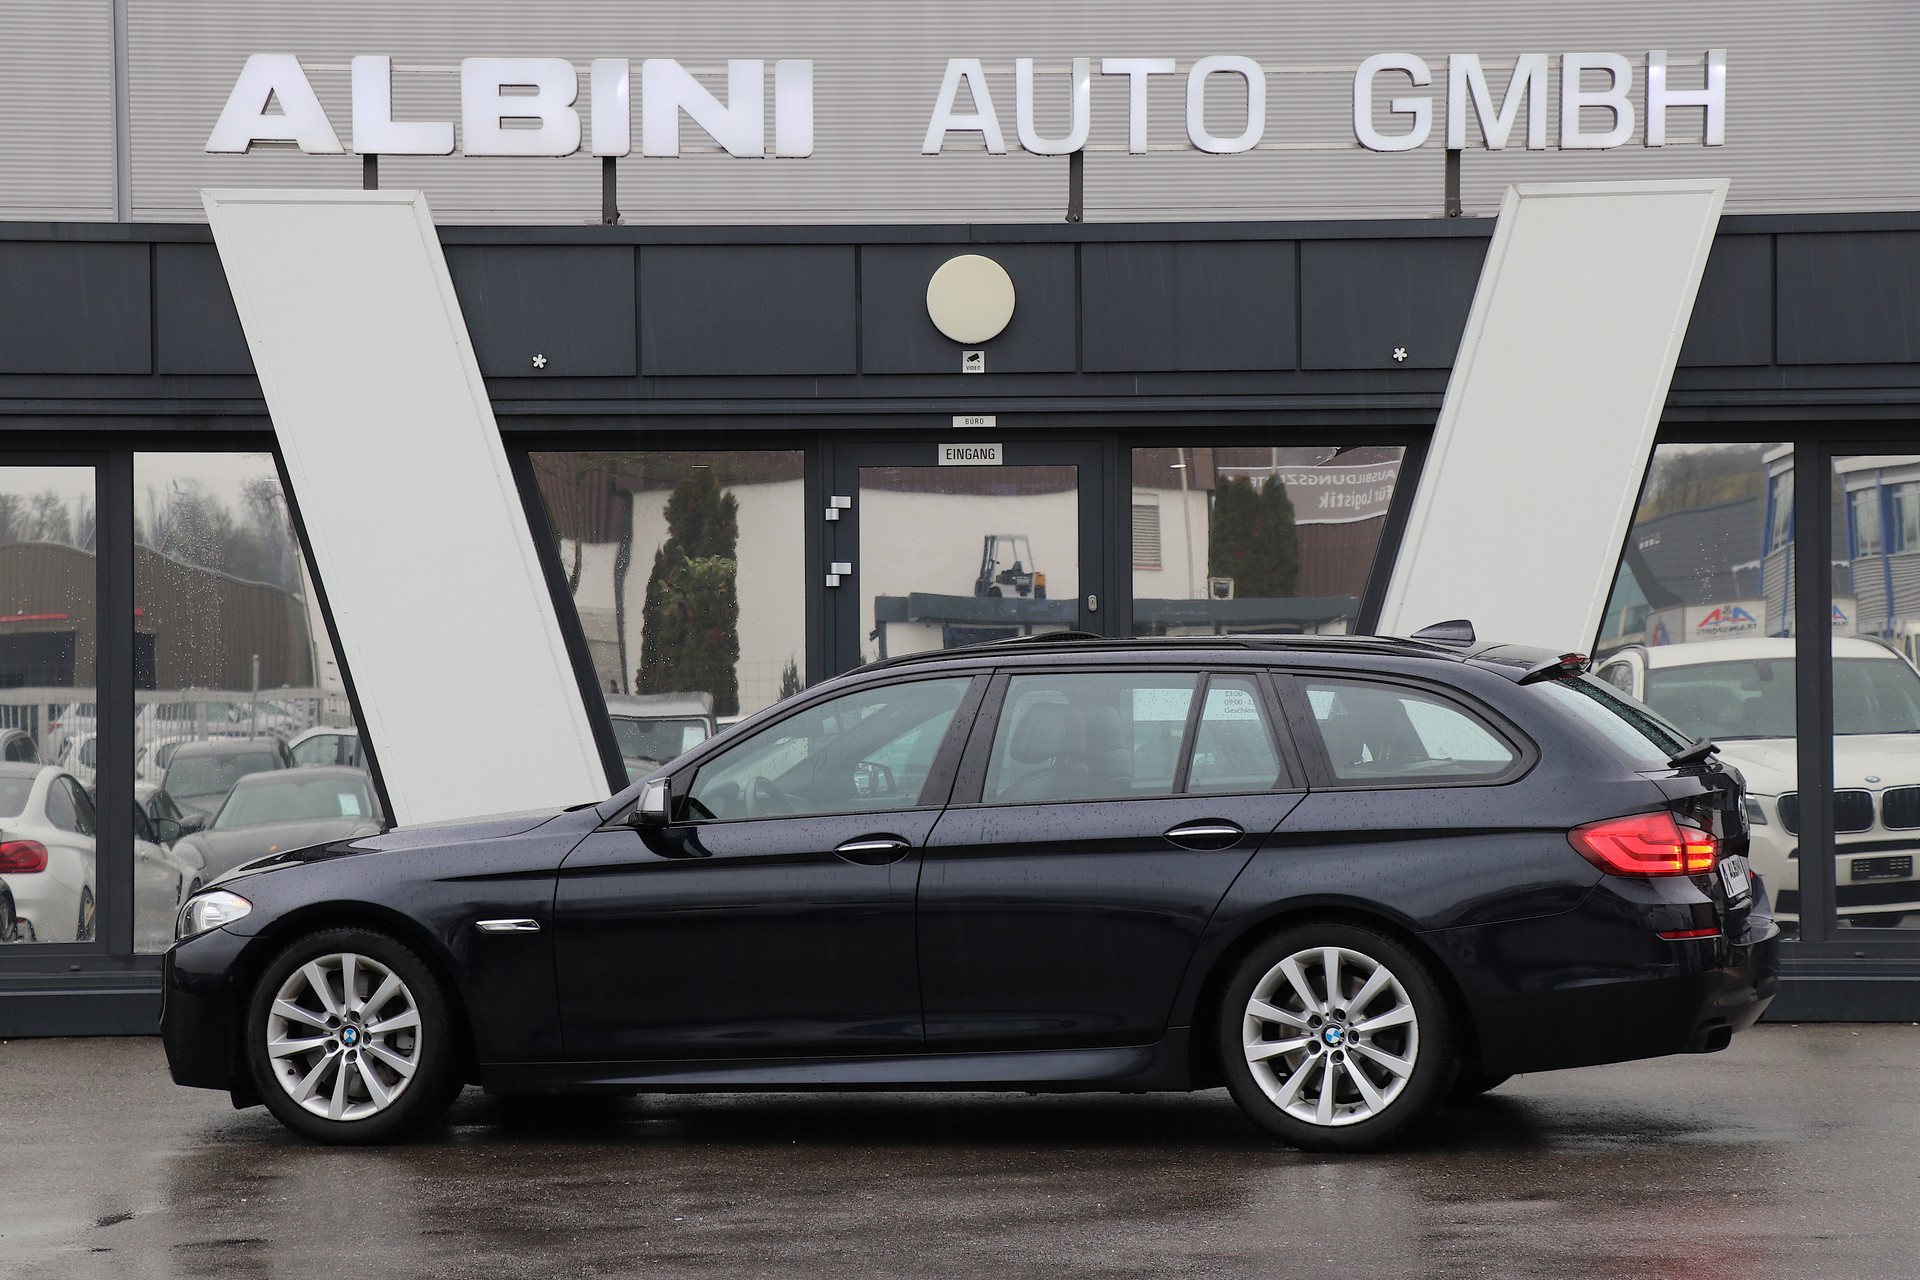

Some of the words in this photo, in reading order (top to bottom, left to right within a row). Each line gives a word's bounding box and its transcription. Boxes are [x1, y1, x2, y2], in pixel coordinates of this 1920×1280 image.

[205, 54, 813, 158] ALBINI
[921, 55, 1266, 156] AUTO
[1352, 49, 1727, 153] GMBH
[965, 417, 984, 425] BÜRO
[946, 448, 995, 460] EINGANG
